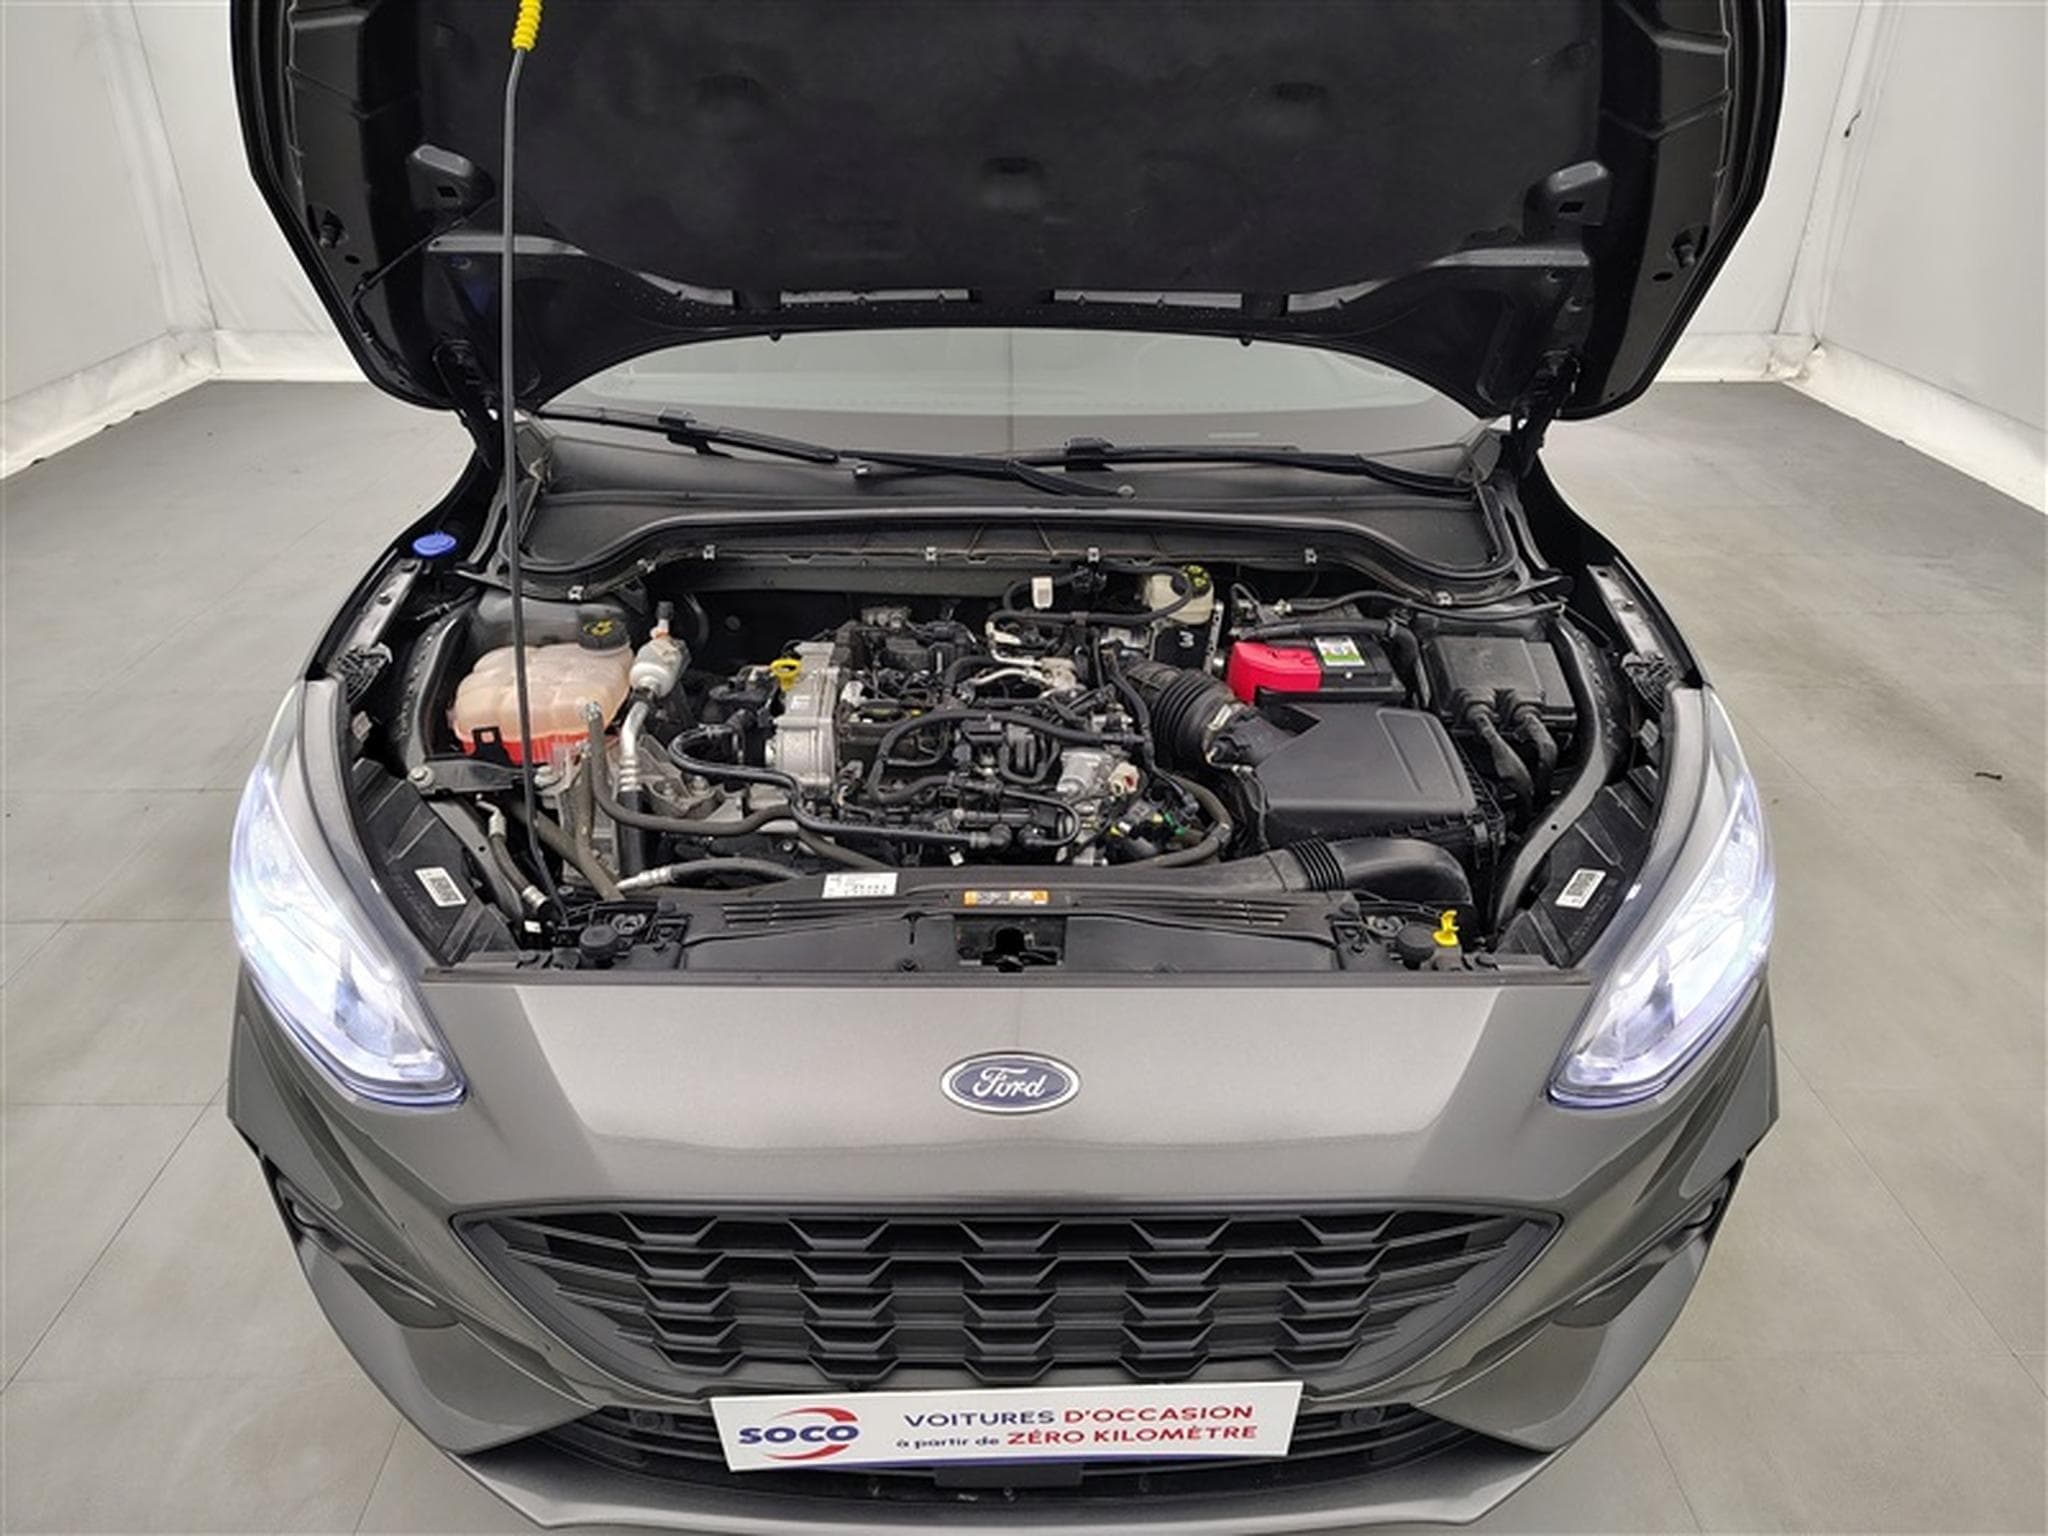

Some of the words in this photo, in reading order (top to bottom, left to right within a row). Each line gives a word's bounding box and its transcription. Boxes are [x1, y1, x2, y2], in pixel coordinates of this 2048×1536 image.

[972, 1066, 1048, 1098] Ford
[903, 1410, 1056, 1428] VOITURES
[1063, 1405, 1254, 1424] D'OCCASION
[737, 1424, 860, 1445] SOCO
[914, 1437, 968, 1449] partir
[974, 1435, 1000, 1447] de
[1006, 1428, 1086, 1446] ZÉRO
[1093, 1425, 1259, 1443] KILOMÈTRE
